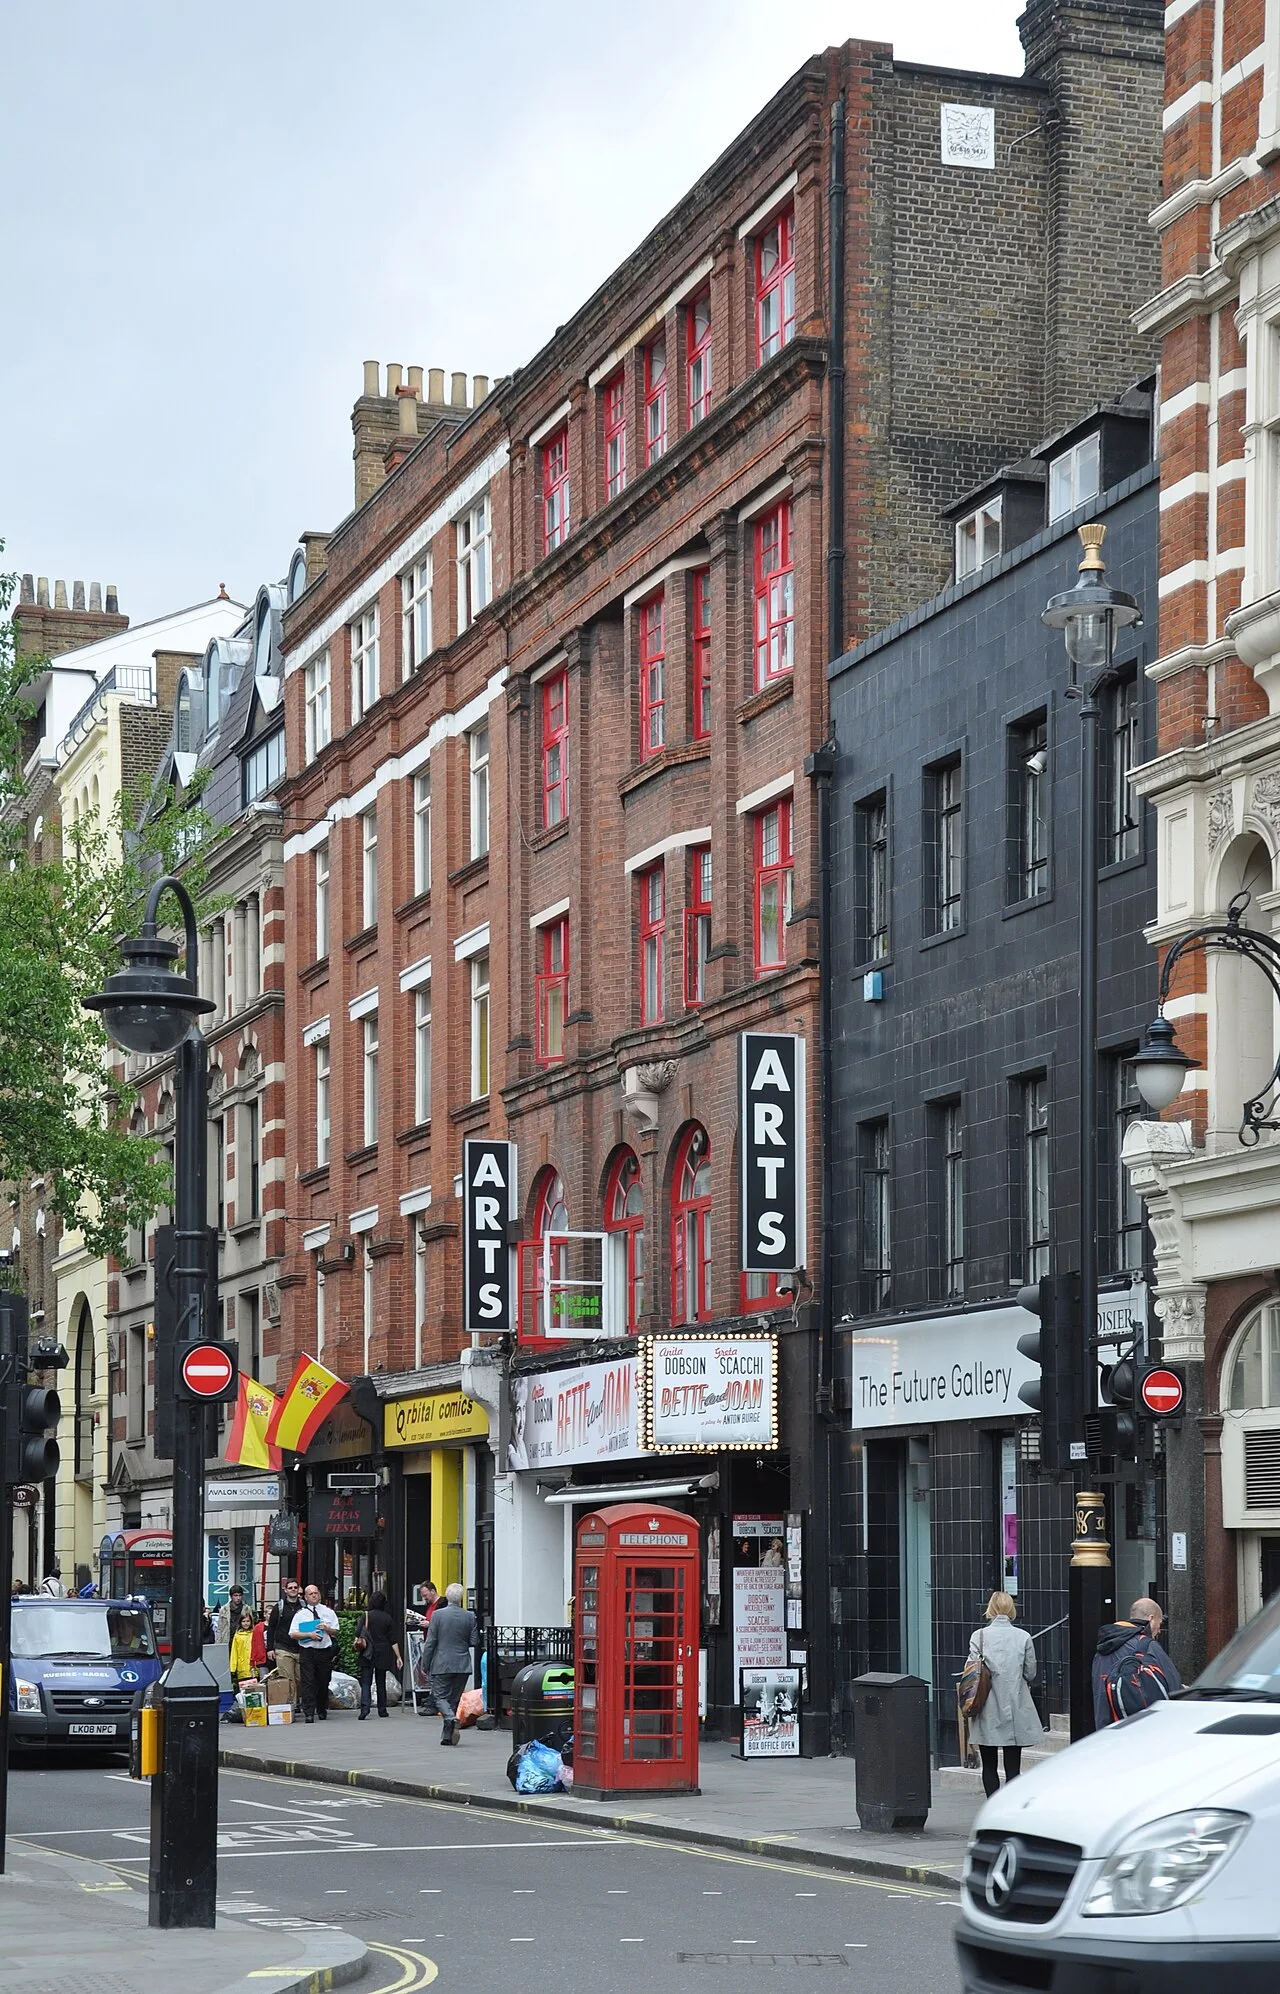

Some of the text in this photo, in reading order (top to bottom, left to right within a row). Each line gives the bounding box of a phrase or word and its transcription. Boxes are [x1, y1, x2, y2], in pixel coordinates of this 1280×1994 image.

[749, 1048, 791, 1256] ARTS
[472, 1153, 506, 1319] ARTS
[659, 1347, 738, 1359] Anita Greta
[665, 1356, 763, 1375] DOBSON SCACCHI
[859, 1361, 1012, 1408] The Future Gallery
[660, 1384, 709, 1418] BETTE
[721, 1378, 764, 1411] JOAN
[396, 1395, 474, 1437] Orbital comics
[557, 1381, 591, 1456] BETTE
[599, 1363, 631, 1439] JOAN
[723, 1414, 741, 1425] ANTON
[332, 1497, 354, 1506] BAR
[328, 1510, 361, 1520] TAPAS
[325, 1524, 361, 1532] FIESTA
[622, 1534, 685, 1544] TELEPHONE
[213, 1535, 230, 1594] Nemeta
[72, 1725, 114, 1734] LK08 NPC
[748, 1741, 795, 1750] BOX OFFICE OPEN
